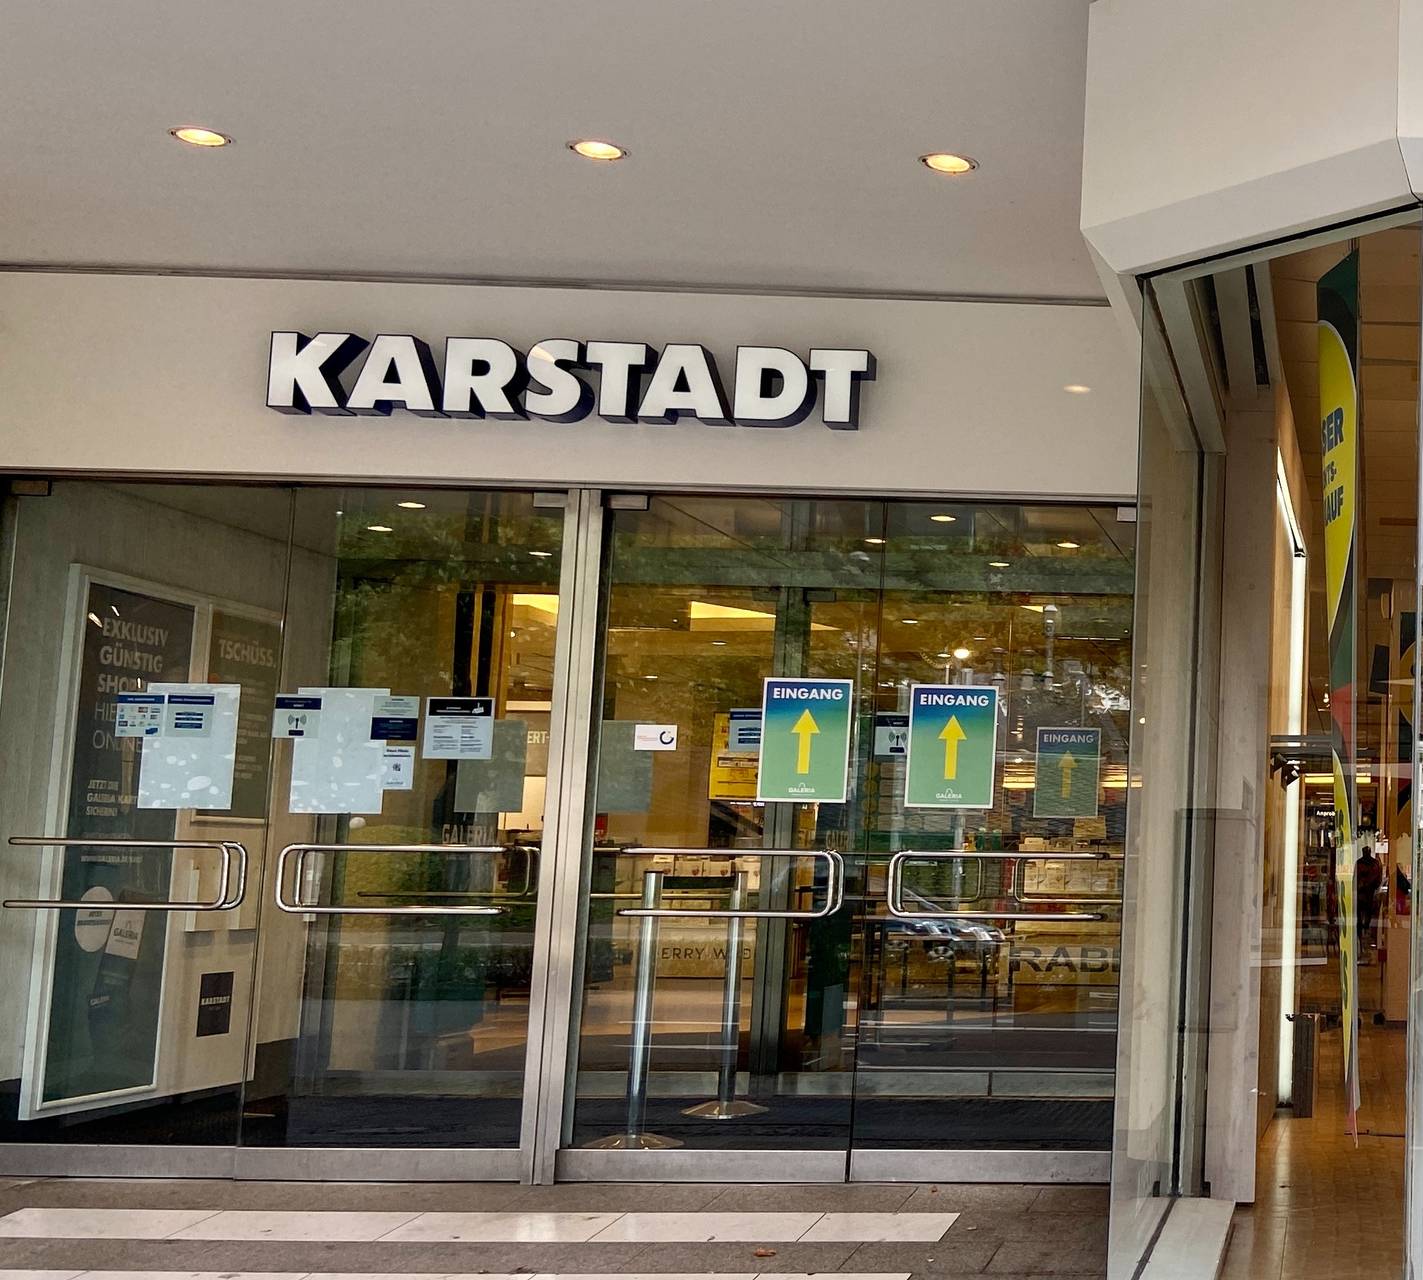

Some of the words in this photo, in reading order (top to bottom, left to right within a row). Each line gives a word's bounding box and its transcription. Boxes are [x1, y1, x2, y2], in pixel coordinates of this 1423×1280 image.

[266, 331, 876, 430] KARSTADT
[102, 618, 169, 648] EXKLUSIV
[100, 643, 163, 672] GÜNSTIG
[218, 638, 277, 668] TSCHÜSS.
[773, 687, 844, 700] EINGANG
[919, 694, 989, 707] EINGANG
[1043, 734, 1095, 744] EINGANG
[660, 947, 705, 960] ERRY
